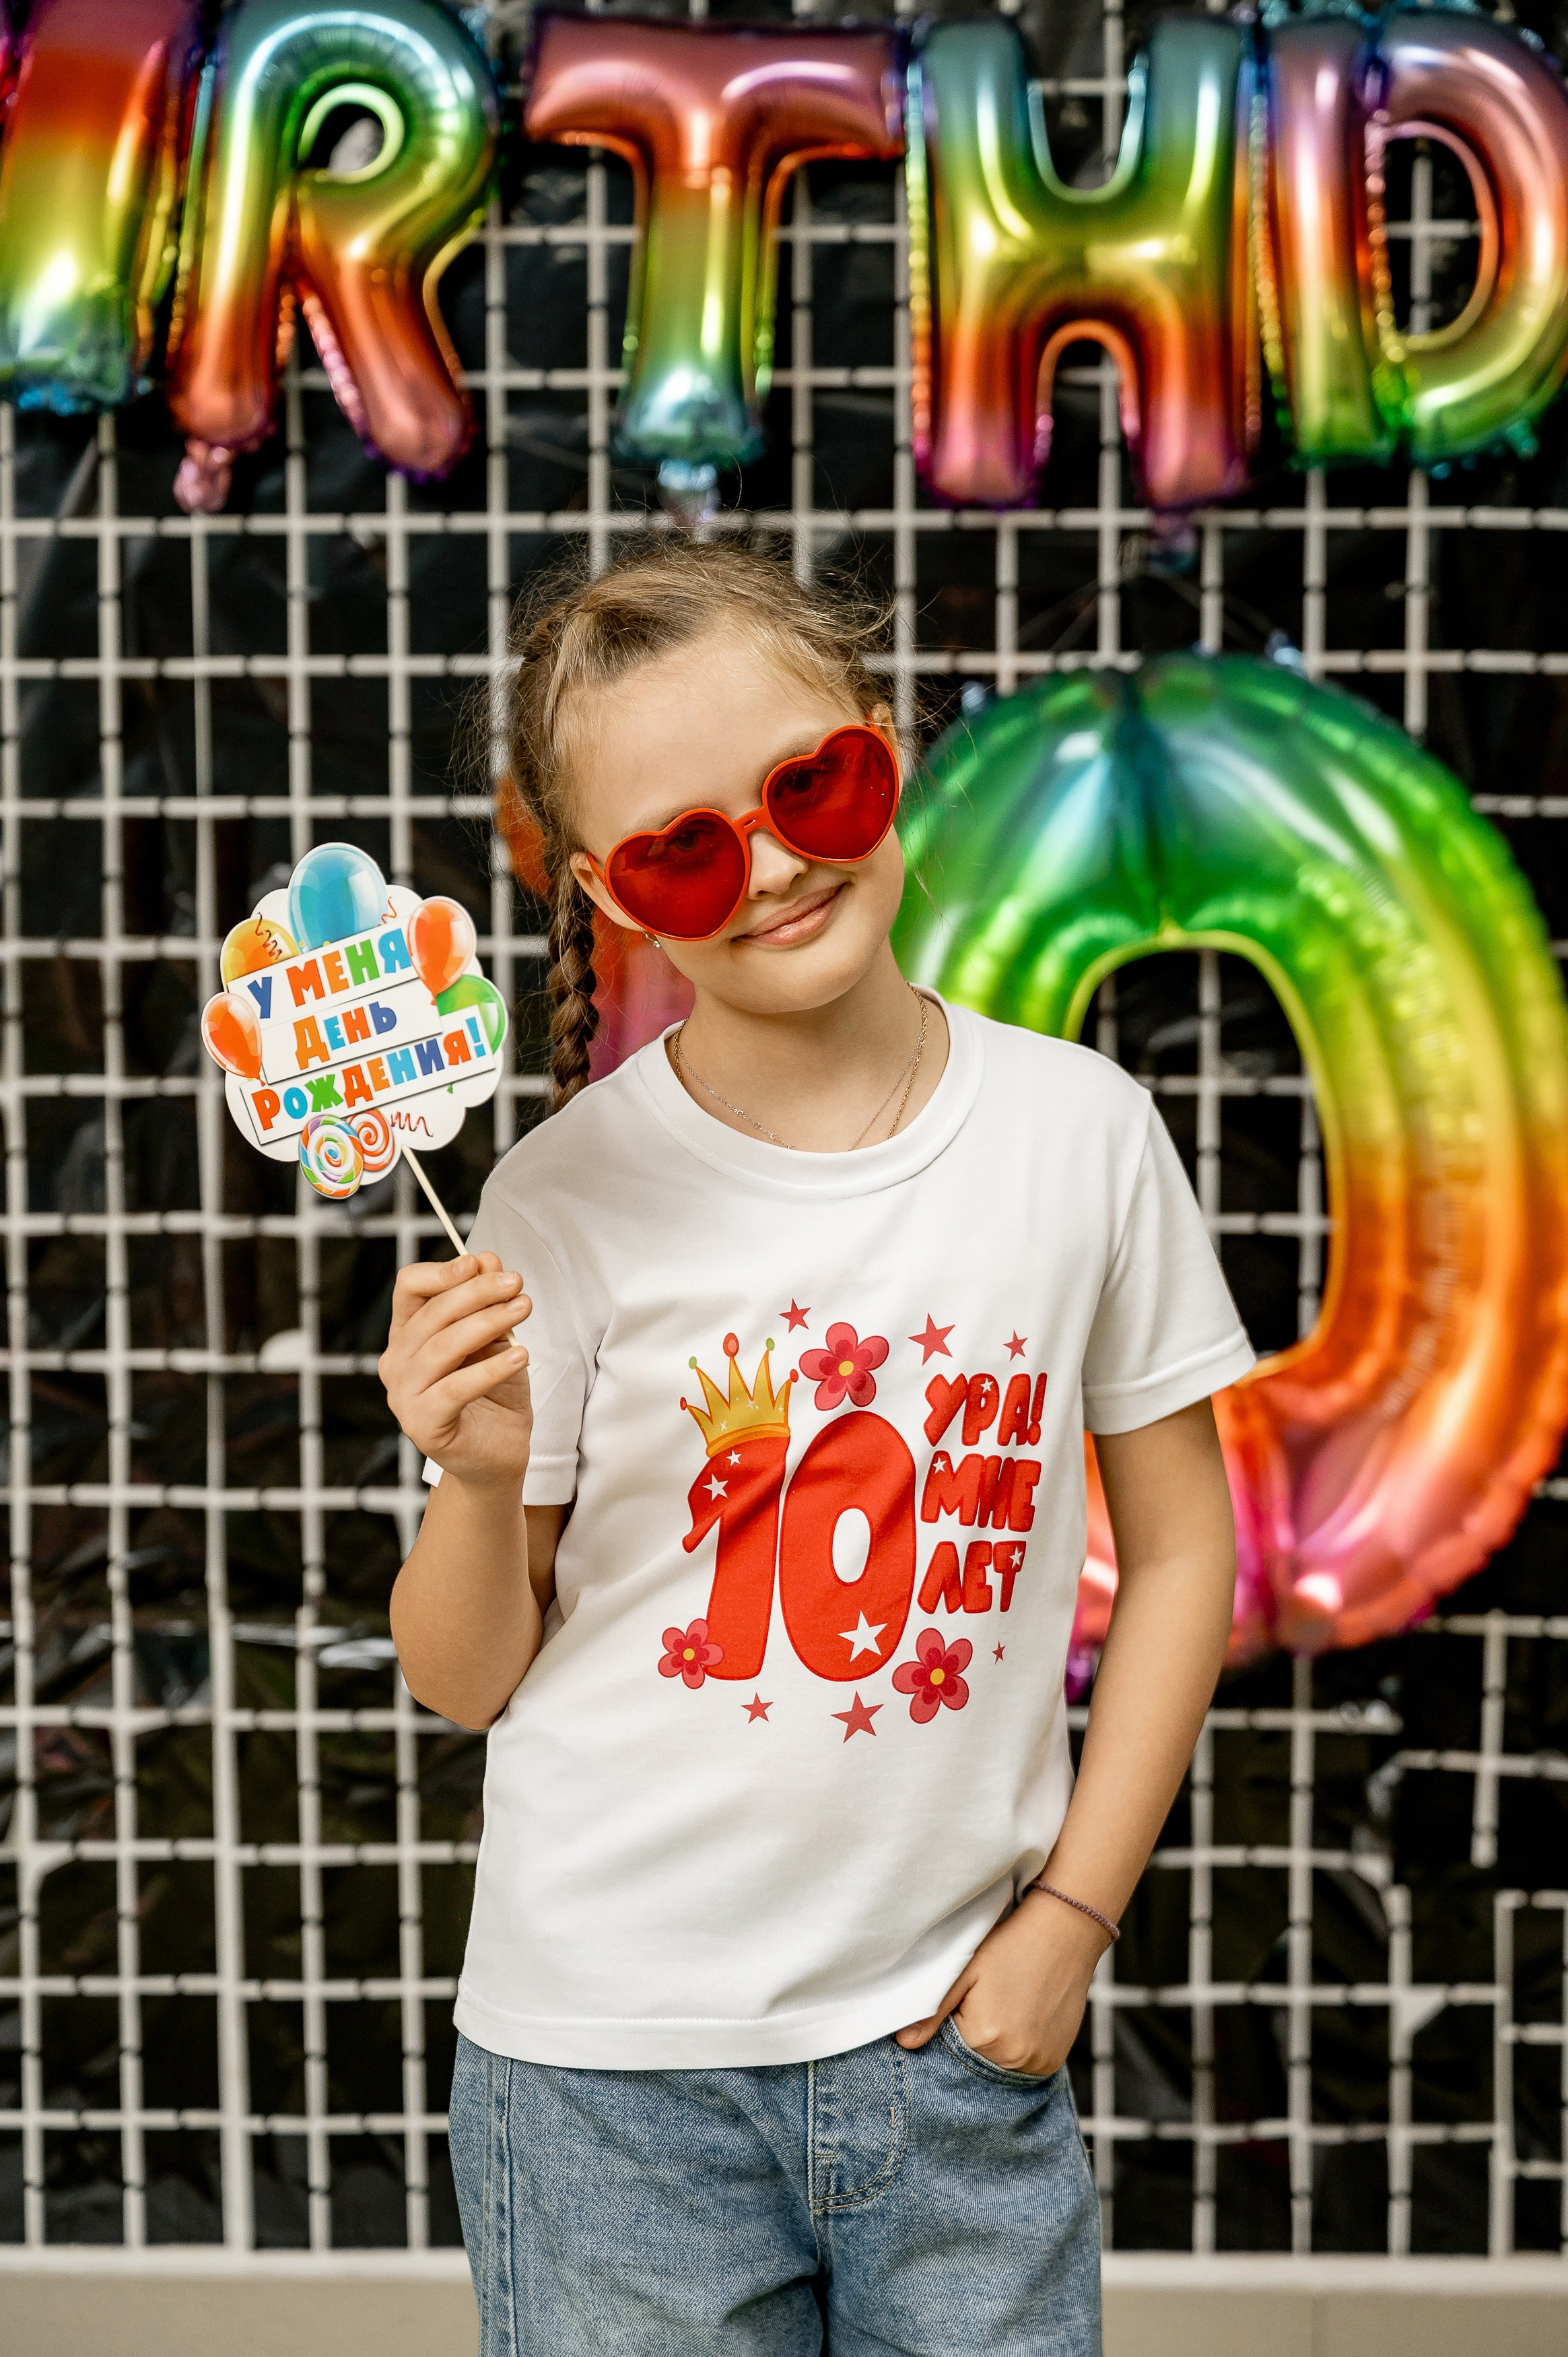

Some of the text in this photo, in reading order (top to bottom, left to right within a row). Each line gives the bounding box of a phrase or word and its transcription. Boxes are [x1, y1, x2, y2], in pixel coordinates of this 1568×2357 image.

[248, 927, 412, 1019] У МЕНЯ
[250, 1016, 487, 1131] РОЖДЕНИЯ!
[292, 1001, 397, 1070] ДЕНЬ
[924, 1372, 1048, 1447] УРА!
[920, 1451, 1042, 1532] МНЕ
[681, 1410, 917, 1682] 10
[917, 1540, 1027, 1614] ЛЕТ
